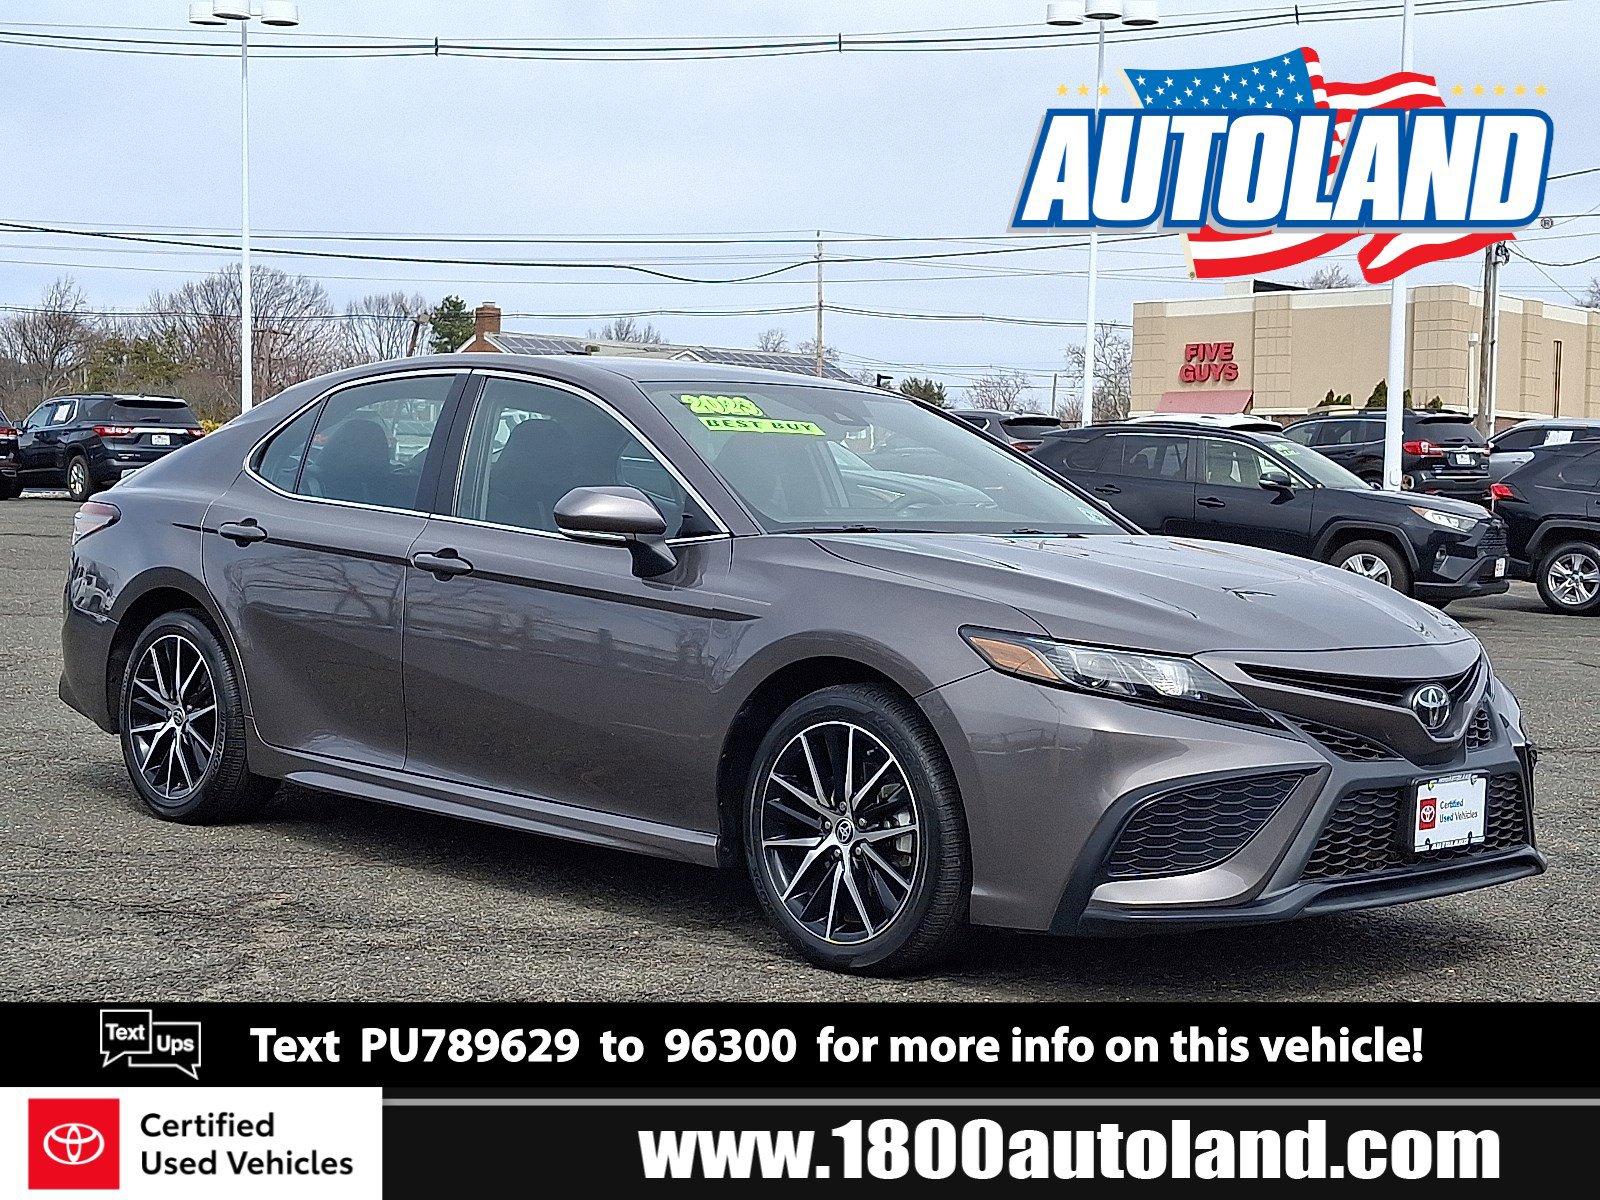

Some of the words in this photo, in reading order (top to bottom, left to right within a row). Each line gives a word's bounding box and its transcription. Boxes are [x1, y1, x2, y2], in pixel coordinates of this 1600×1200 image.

[1185, 342, 1234, 362] FIVE
[1180, 363, 1238, 382] GUYS
[706, 419, 760, 429] BEST
[771, 422, 812, 431] BUY
[1439, 798, 1464, 810] Certified
[1439, 813, 1454, 823] Used
[1455, 810, 1478, 821] Vehicles
